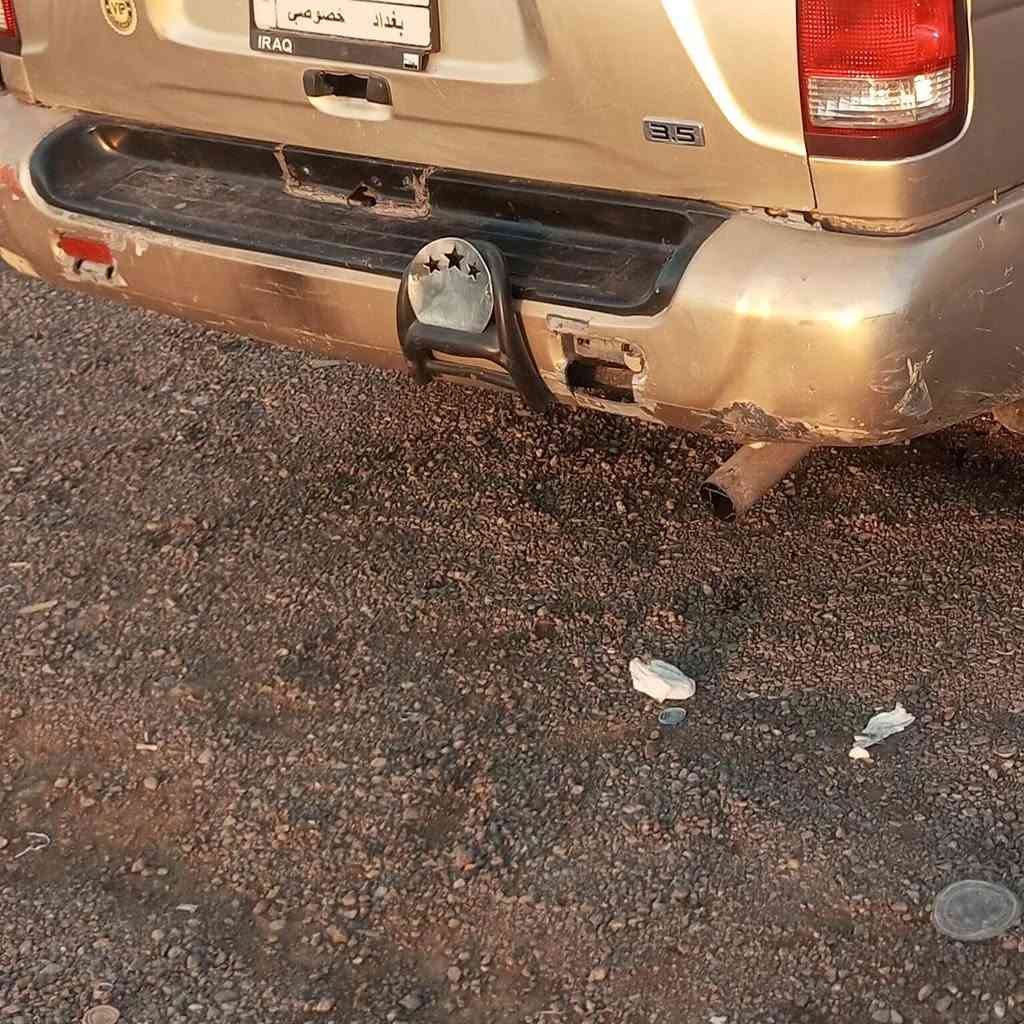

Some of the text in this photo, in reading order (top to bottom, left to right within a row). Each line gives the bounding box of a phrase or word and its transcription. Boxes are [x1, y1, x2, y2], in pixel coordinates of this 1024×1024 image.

[287, 7, 404, 37] بغداد خصوصي
[258, 35, 293, 54] IRAQ
